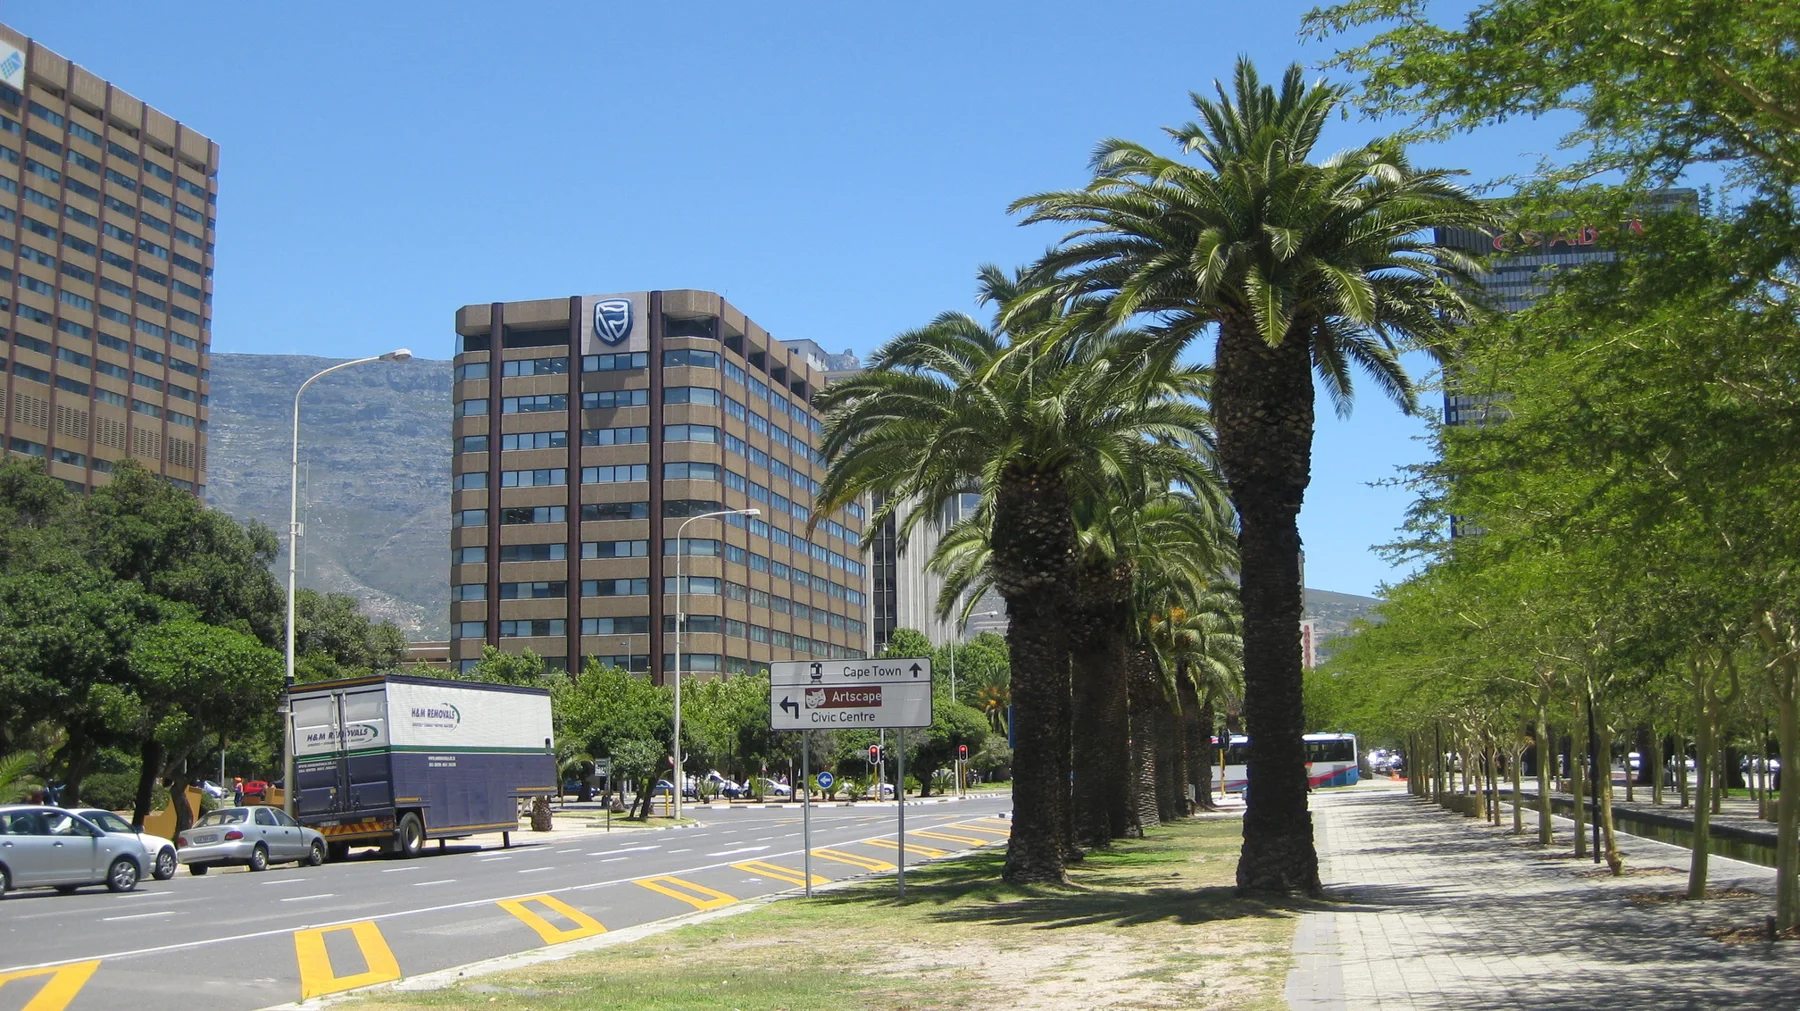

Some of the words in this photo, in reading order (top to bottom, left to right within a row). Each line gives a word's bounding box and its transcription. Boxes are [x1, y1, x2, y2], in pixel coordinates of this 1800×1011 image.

[843, 666, 870, 680] Cape
[872, 665, 902, 676] Town
[832, 691, 882, 704] Artscape
[411, 708, 425, 718] H&M
[427, 708, 455, 719] REMOVALS
[811, 711, 836, 723] Civic
[839, 711, 876, 722] Centre
[306, 732, 326, 742] H&M
